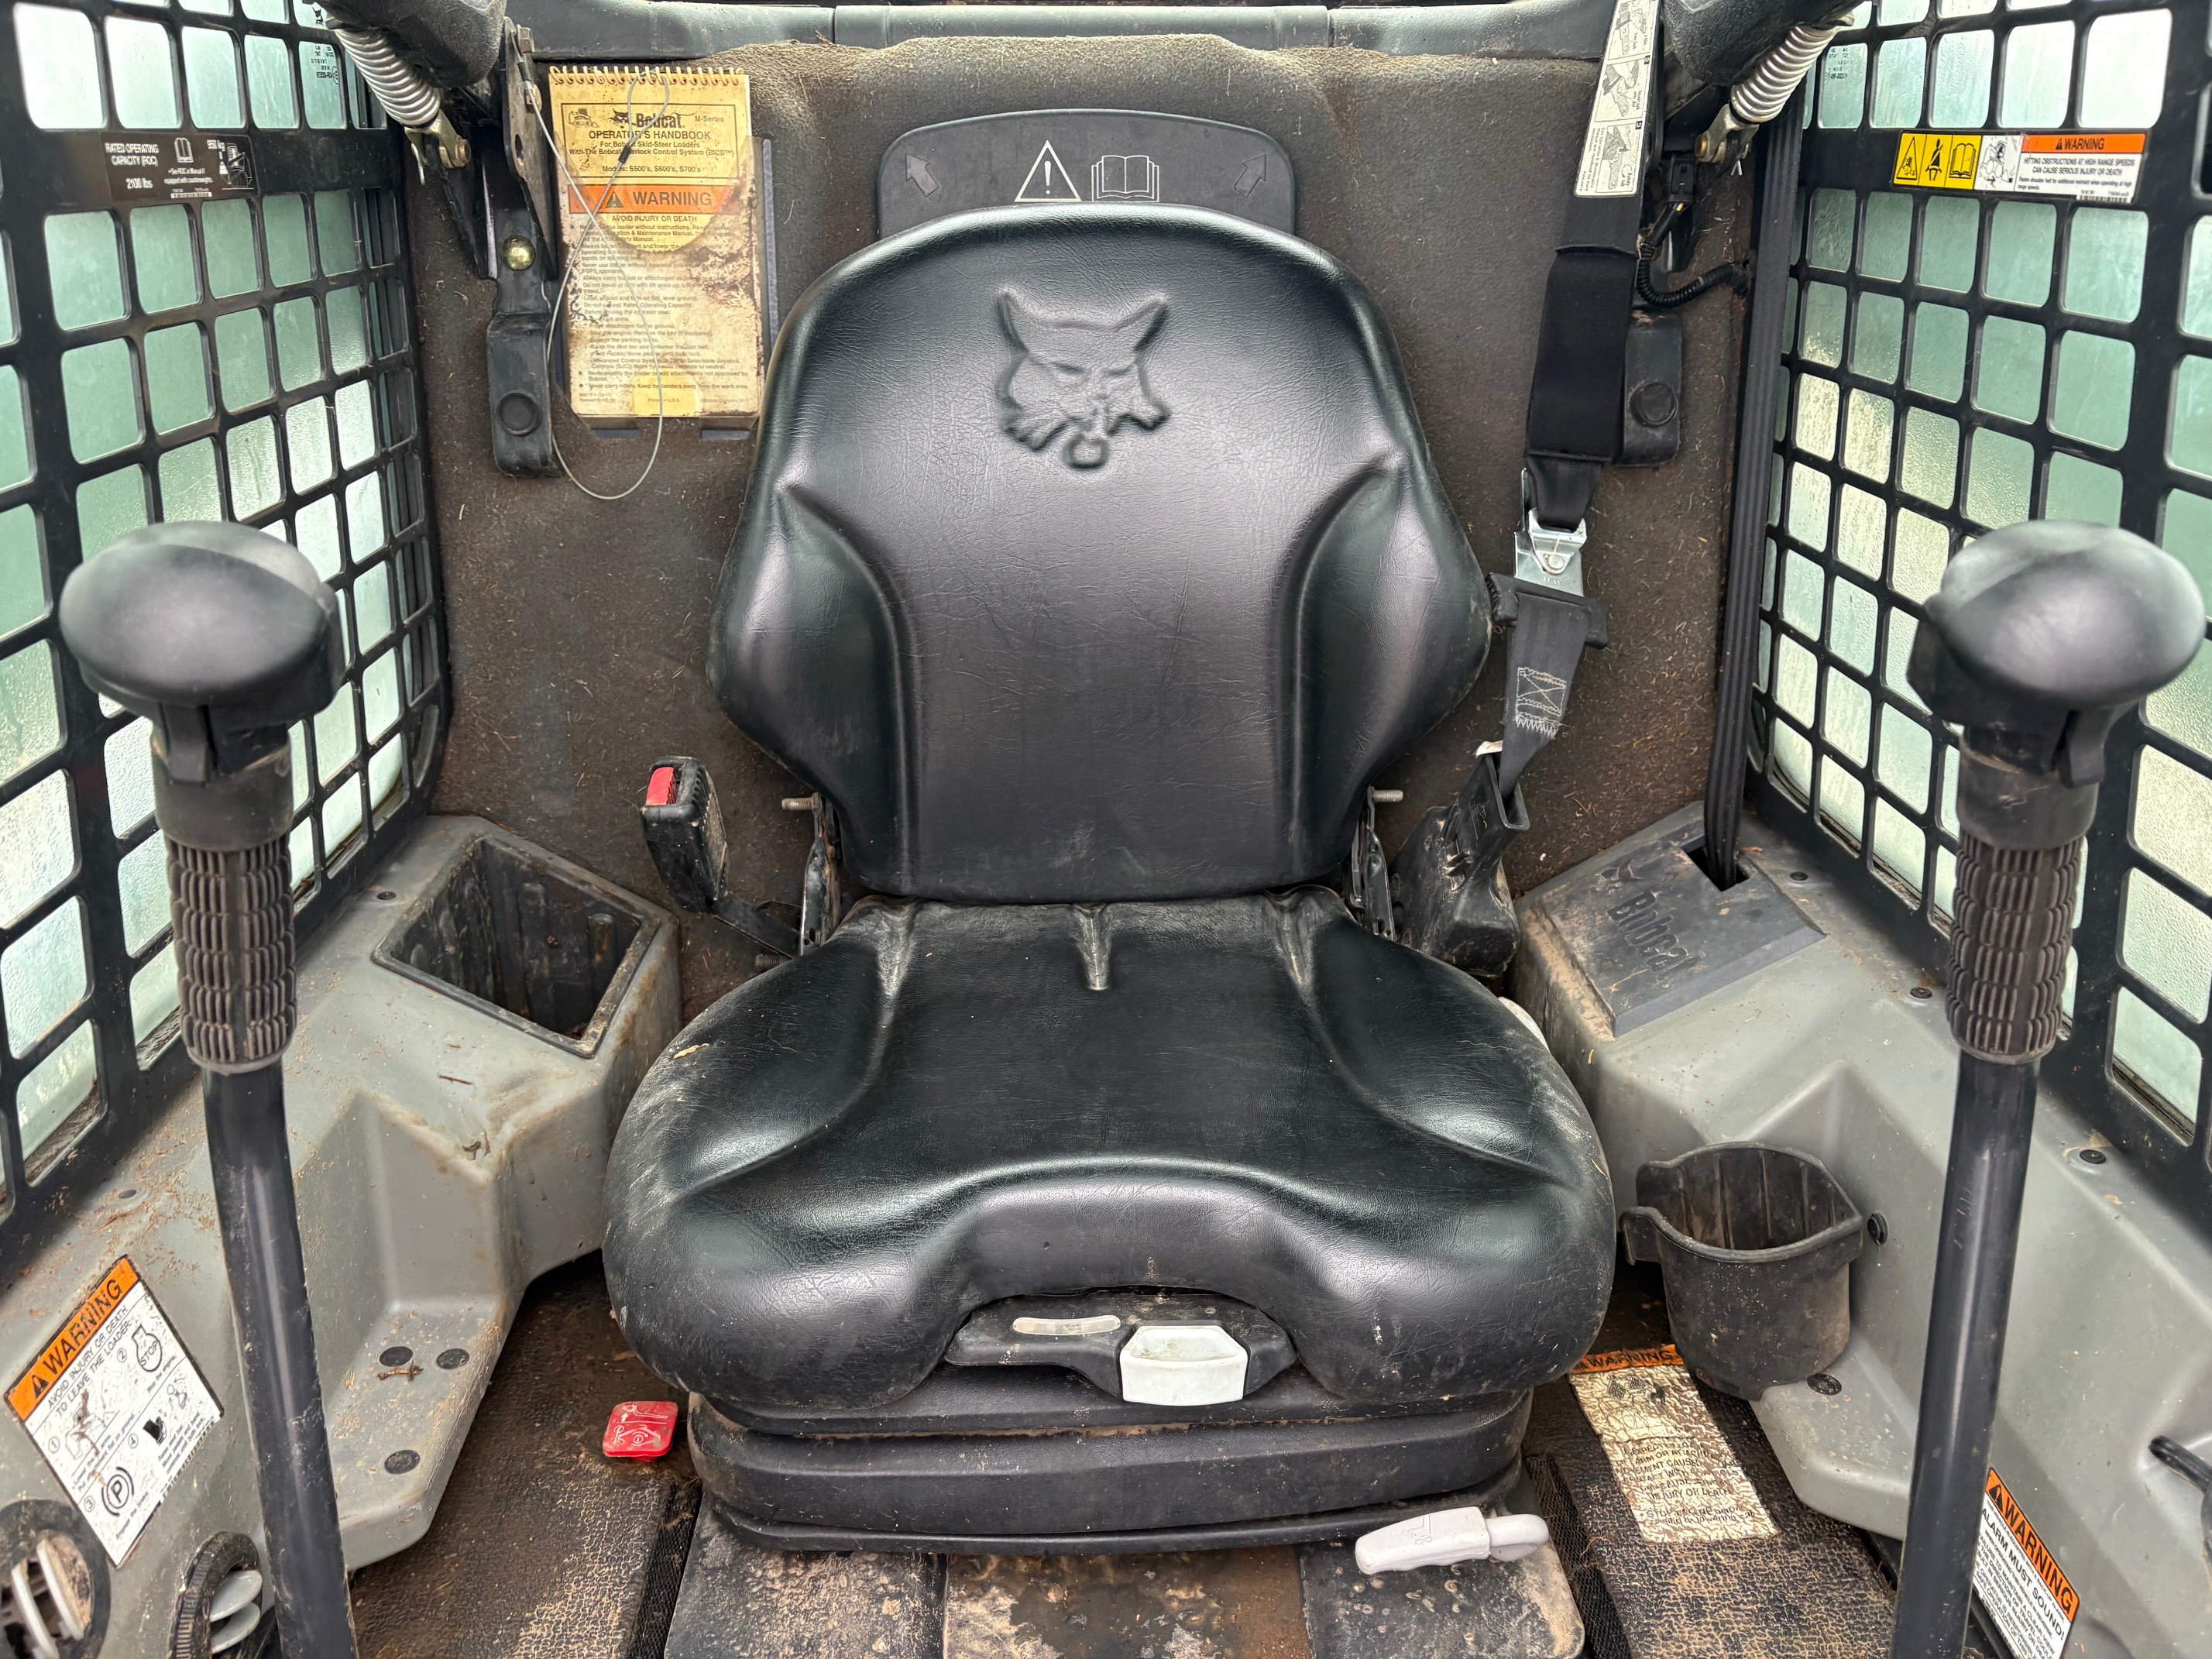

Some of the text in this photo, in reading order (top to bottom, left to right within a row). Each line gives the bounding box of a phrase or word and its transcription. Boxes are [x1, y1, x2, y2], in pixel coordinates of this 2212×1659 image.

[589, 130, 711, 139] OPERATORS HANDBOOK
[2064, 138, 2105, 149] WARNING
[633, 191, 713, 206] WARNING
[1606, 890, 1702, 983] Bobcat
[42, 1275, 123, 1379] WARNING
[46, 1304, 128, 1410] AVOID INJURY OR DEATH
[139, 1339, 159, 1367] STOP
[56, 1400, 68, 1417] TO
[67, 1371, 90, 1403] LEAVE
[89, 1352, 105, 1374] THE
[1979, 1566, 2007, 1613] OPERATOR IS
[1980, 1544, 2036, 1637] THE DIRECTION OF TRAVEL
[1981, 1506, 2064, 1641] ALARM MUST SOUND!
[2002, 1496, 2074, 1616] WARNING
[1975, 1569, 1987, 1589] SAFE
[1986, 1586, 2011, 1628] OPERATION
[2010, 1625, 2017, 1639] OF
[1987, 1565, 2035, 1647] IN SERIOUS INJURY OR
[1994, 1558, 2002, 1571] TO
[2022, 1602, 2027, 1612] A
[2026, 1609, 2042, 1637] CLEAR
[2042, 1633, 2055, 1657] VIEW
